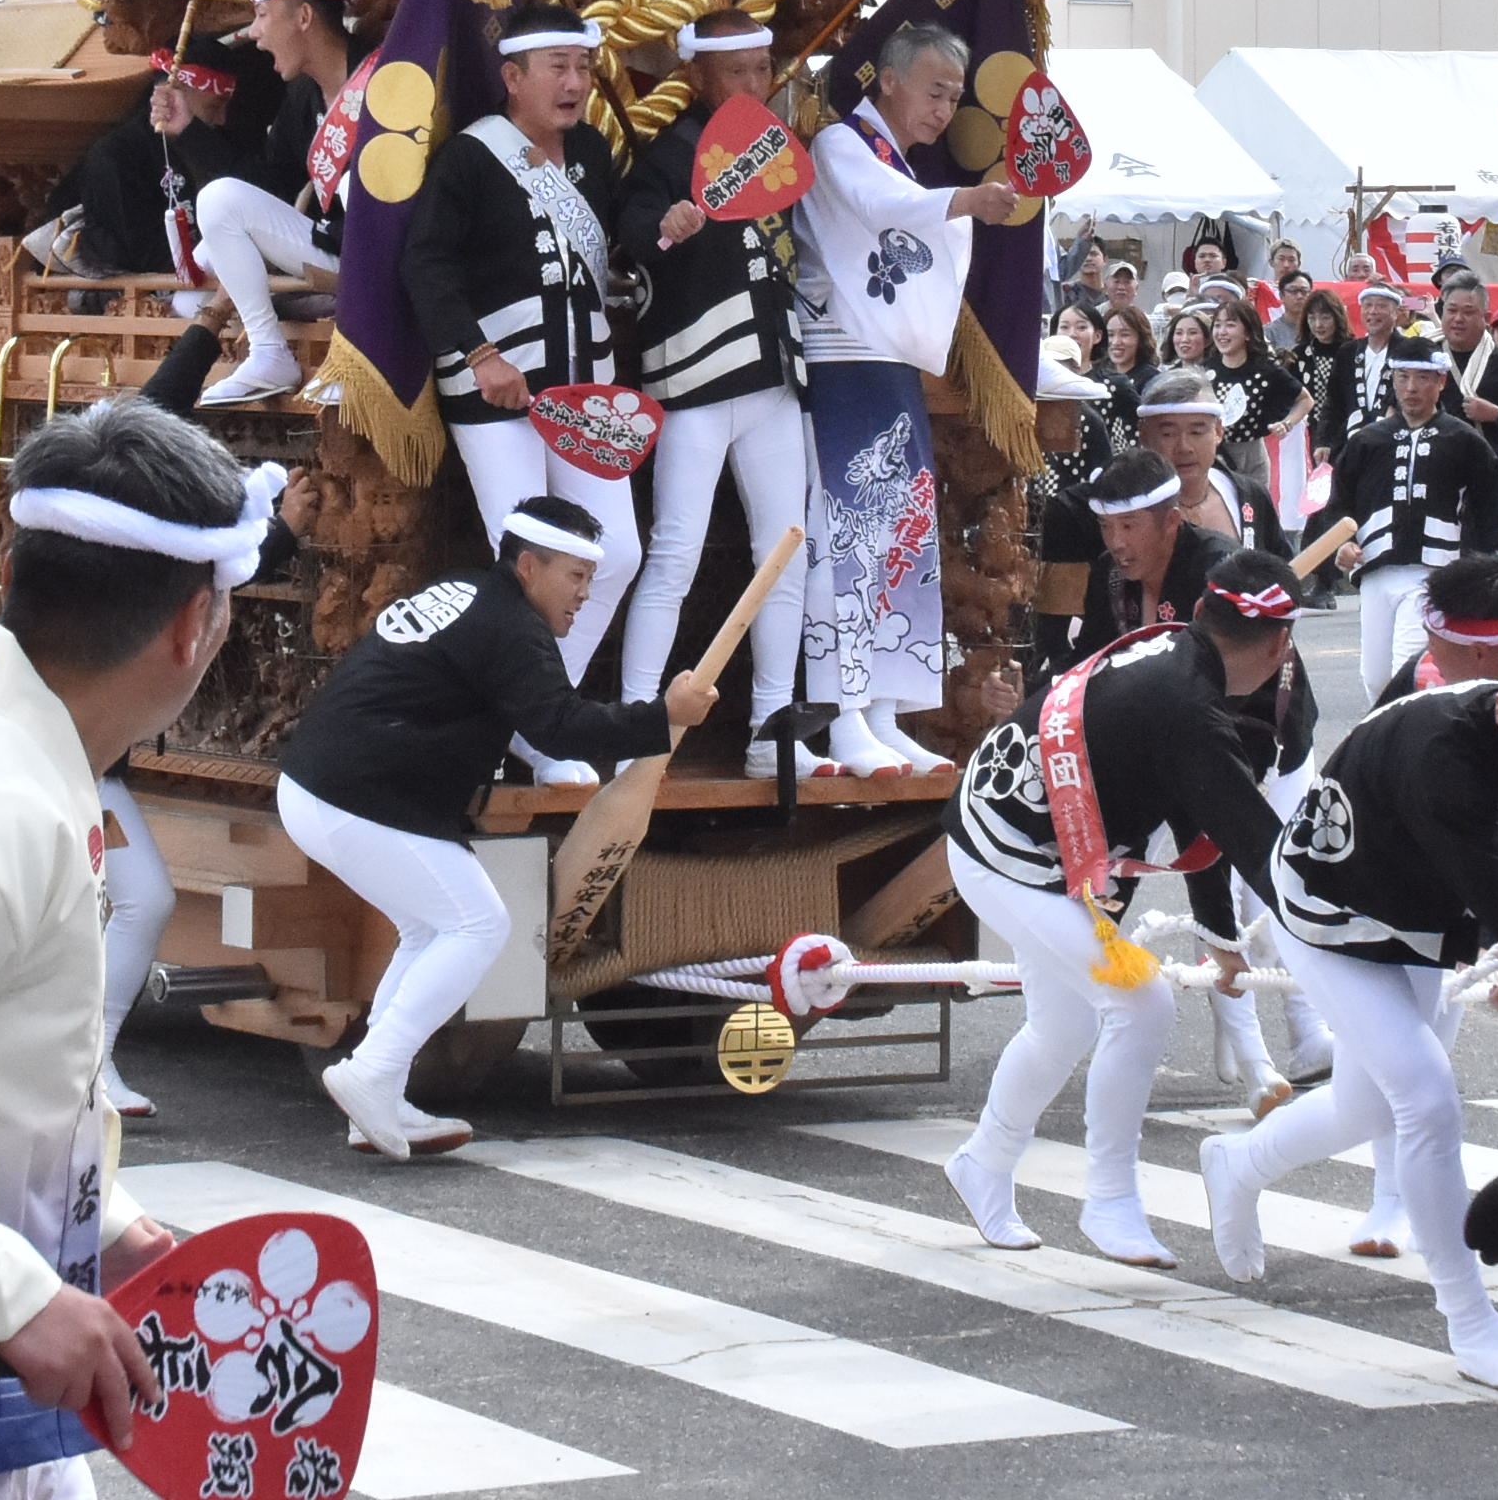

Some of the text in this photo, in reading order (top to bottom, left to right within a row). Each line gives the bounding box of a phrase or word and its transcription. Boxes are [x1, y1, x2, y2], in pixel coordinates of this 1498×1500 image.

[702, 124, 789, 211] 曳行責任者
